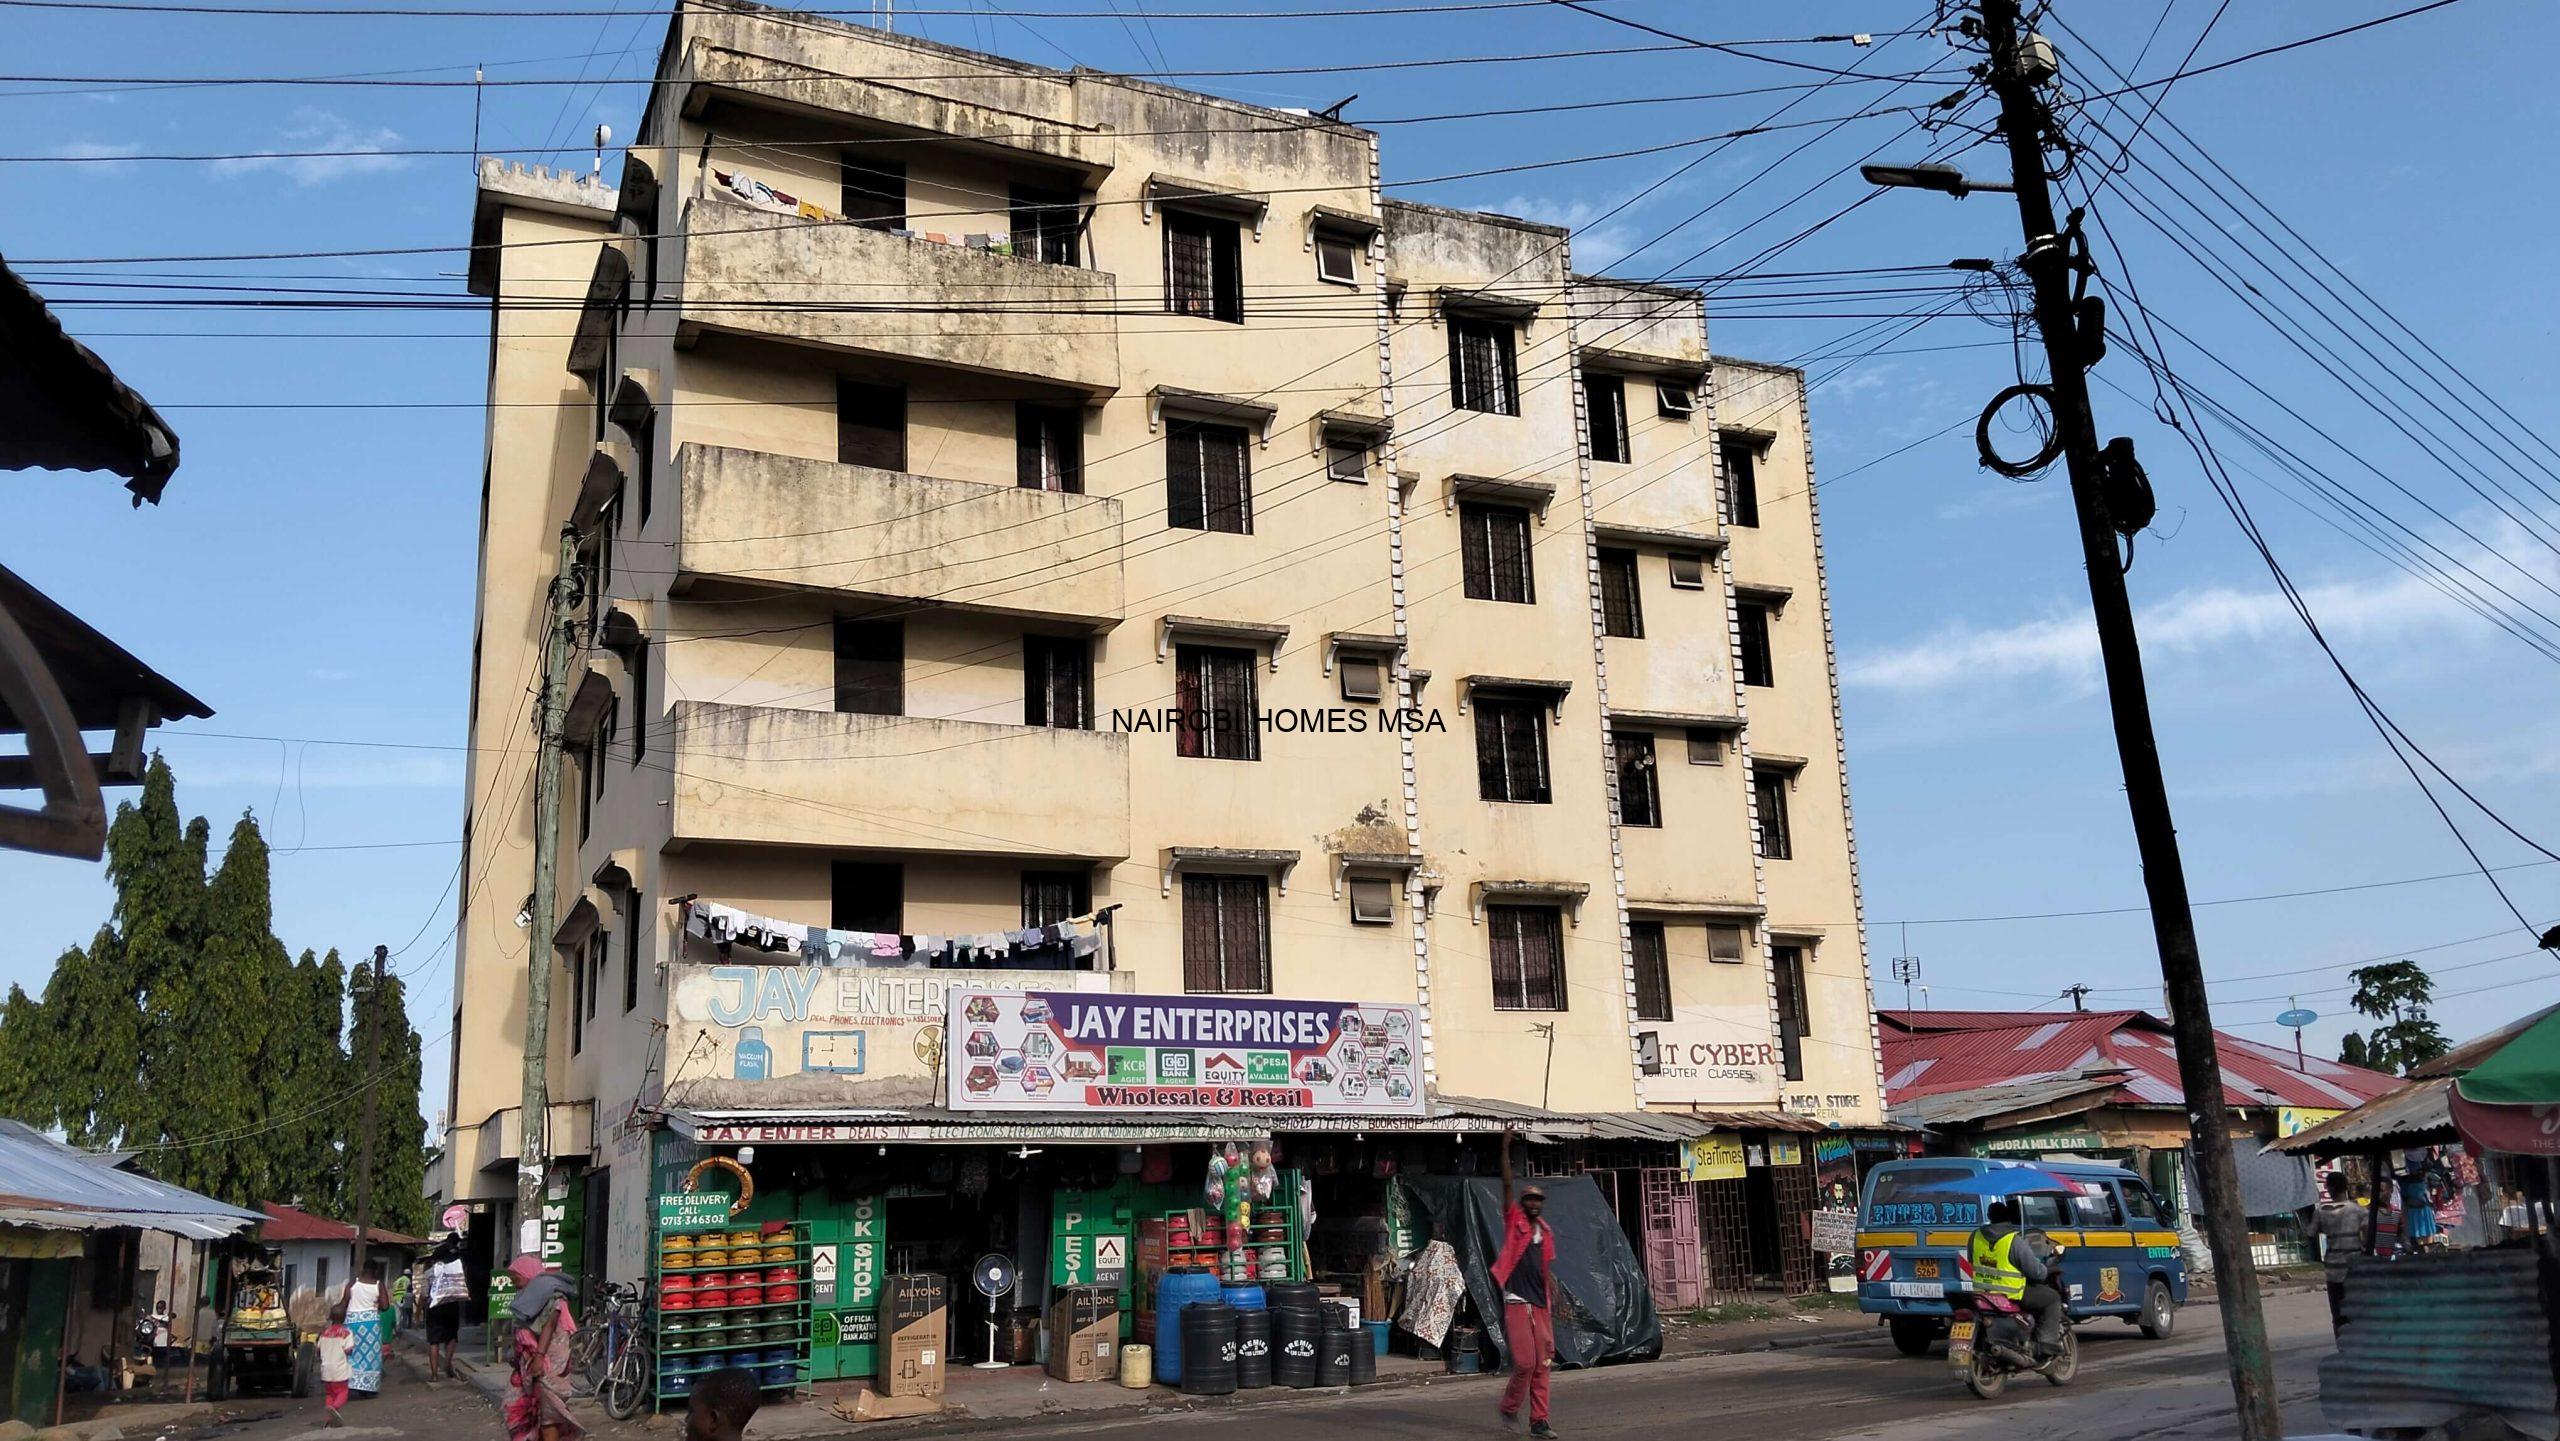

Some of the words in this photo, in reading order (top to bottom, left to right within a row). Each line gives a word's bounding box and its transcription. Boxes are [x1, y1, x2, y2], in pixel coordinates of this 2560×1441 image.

[707, 966, 822, 1028] JAY
[1063, 1005, 1126, 1039] JAY
[1133, 1007, 1330, 1044] ENTERPRISES
[1690, 1043, 1776, 1067] CYBER
[1123, 1060, 1146, 1071] KCB
[1205, 1071, 1246, 1081] EQUITY
[1248, 1073, 1289, 1081] AVAILABLE
[1097, 1088, 1210, 1107] Wholesale
[1216, 1088, 1234, 1107] &
[1240, 1089, 1302, 1107] Retail
[1790, 1095, 1822, 1108] MEGA
[1826, 1095, 1861, 1108] STORE
[1368, 1118, 1424, 1130] BOOKSHOP
[702, 1126, 750, 1140] JAY
[759, 1127, 836, 1140] ENTER
[849, 1126, 889, 1139] DEALS
[2030, 1138, 2060, 1150] MILK
[2061, 1138, 2088, 1149] BAR
[1696, 1144, 1744, 1167] StarTimes
[660, 1195, 684, 1206] FREE
[685, 1194, 729, 1206] DELIVERY
[1871, 1202, 1938, 1225] ENTER
[1941, 1202, 1978, 1224] PIN
[661, 1214, 725, 1226] 0713-346303
[1098, 1257, 1121, 1265] EQUITY
[1096, 1272, 1120, 1282] AGENT
[898, 1286, 941, 1299] AILYONS
[1076, 1295, 1115, 1307] AILYONS
[844, 1314, 876, 1324] OFFICIAL
[843, 1332, 858, 1341] BANK
[858, 1331, 877, 1341] AGENT
